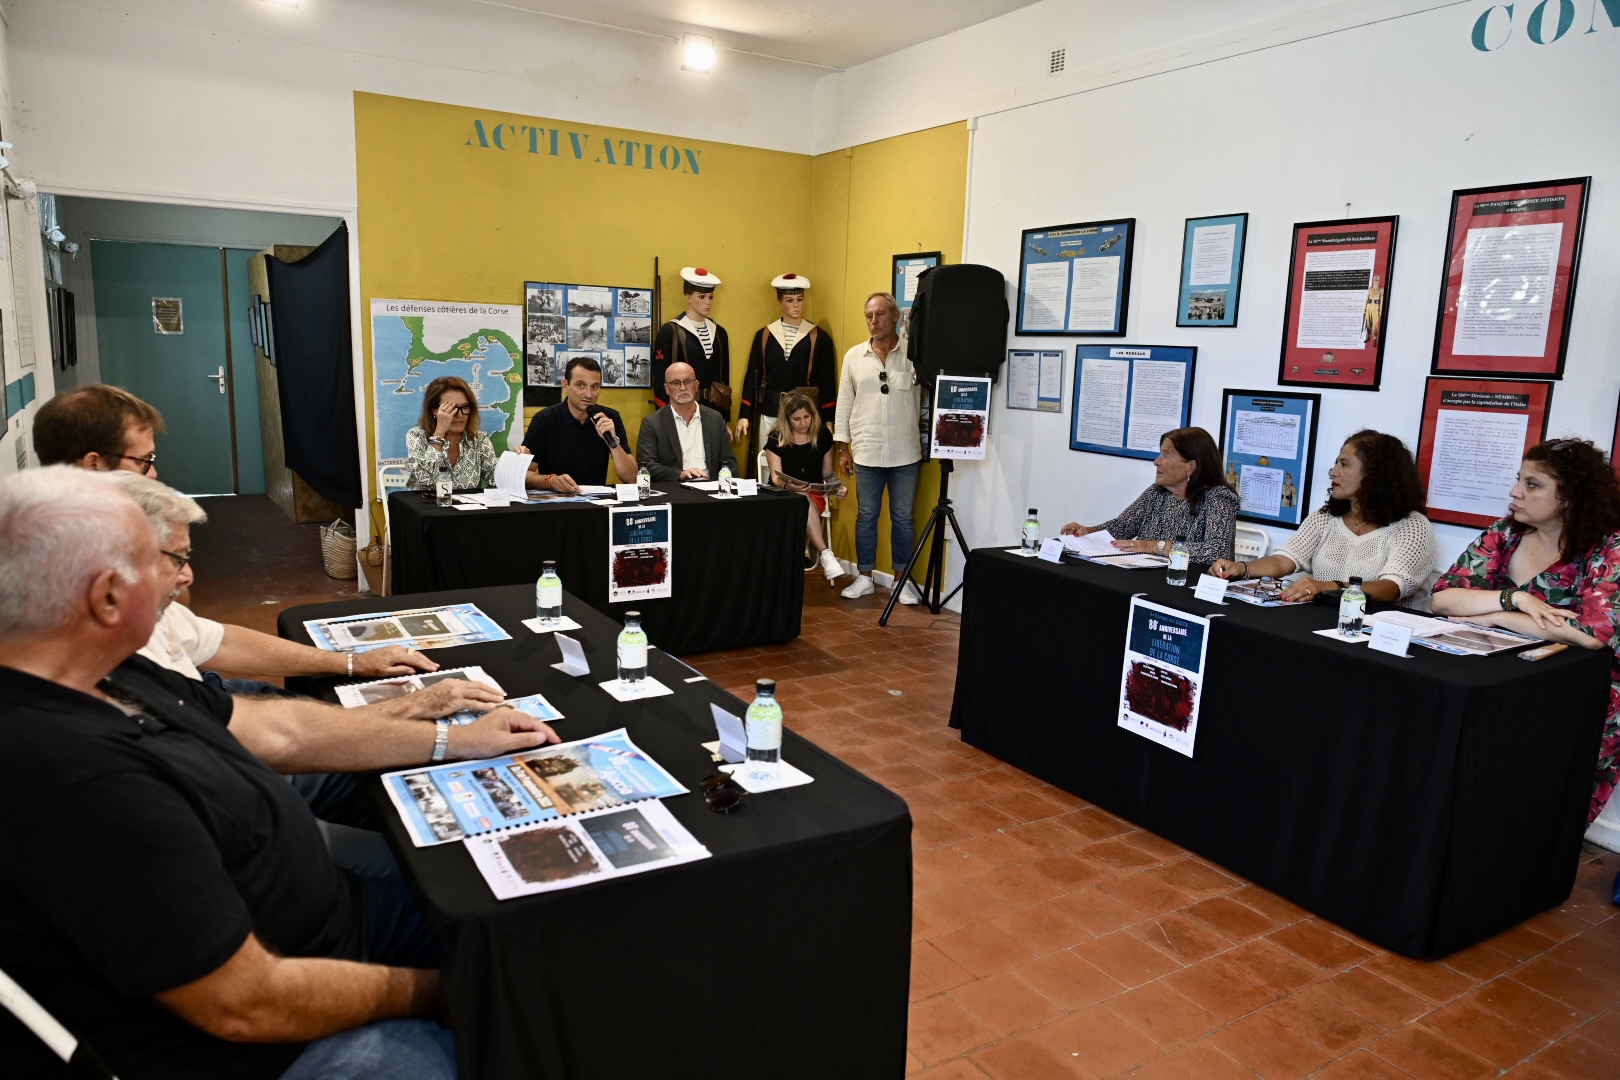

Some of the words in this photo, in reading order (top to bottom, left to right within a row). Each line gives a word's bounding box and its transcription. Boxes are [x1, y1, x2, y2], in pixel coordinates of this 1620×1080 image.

[464, 119, 702, 175] ACTIVATION
[386, 304, 399, 312] Les
[400, 304, 436, 313] défenses
[437, 306, 467, 314] côtières
[469, 306, 479, 314] de
[480, 306, 487, 314] la
[1159, 624, 1188, 636] ANNIVERSAIRE
[1152, 638, 1180, 654] LIBÉRATION
